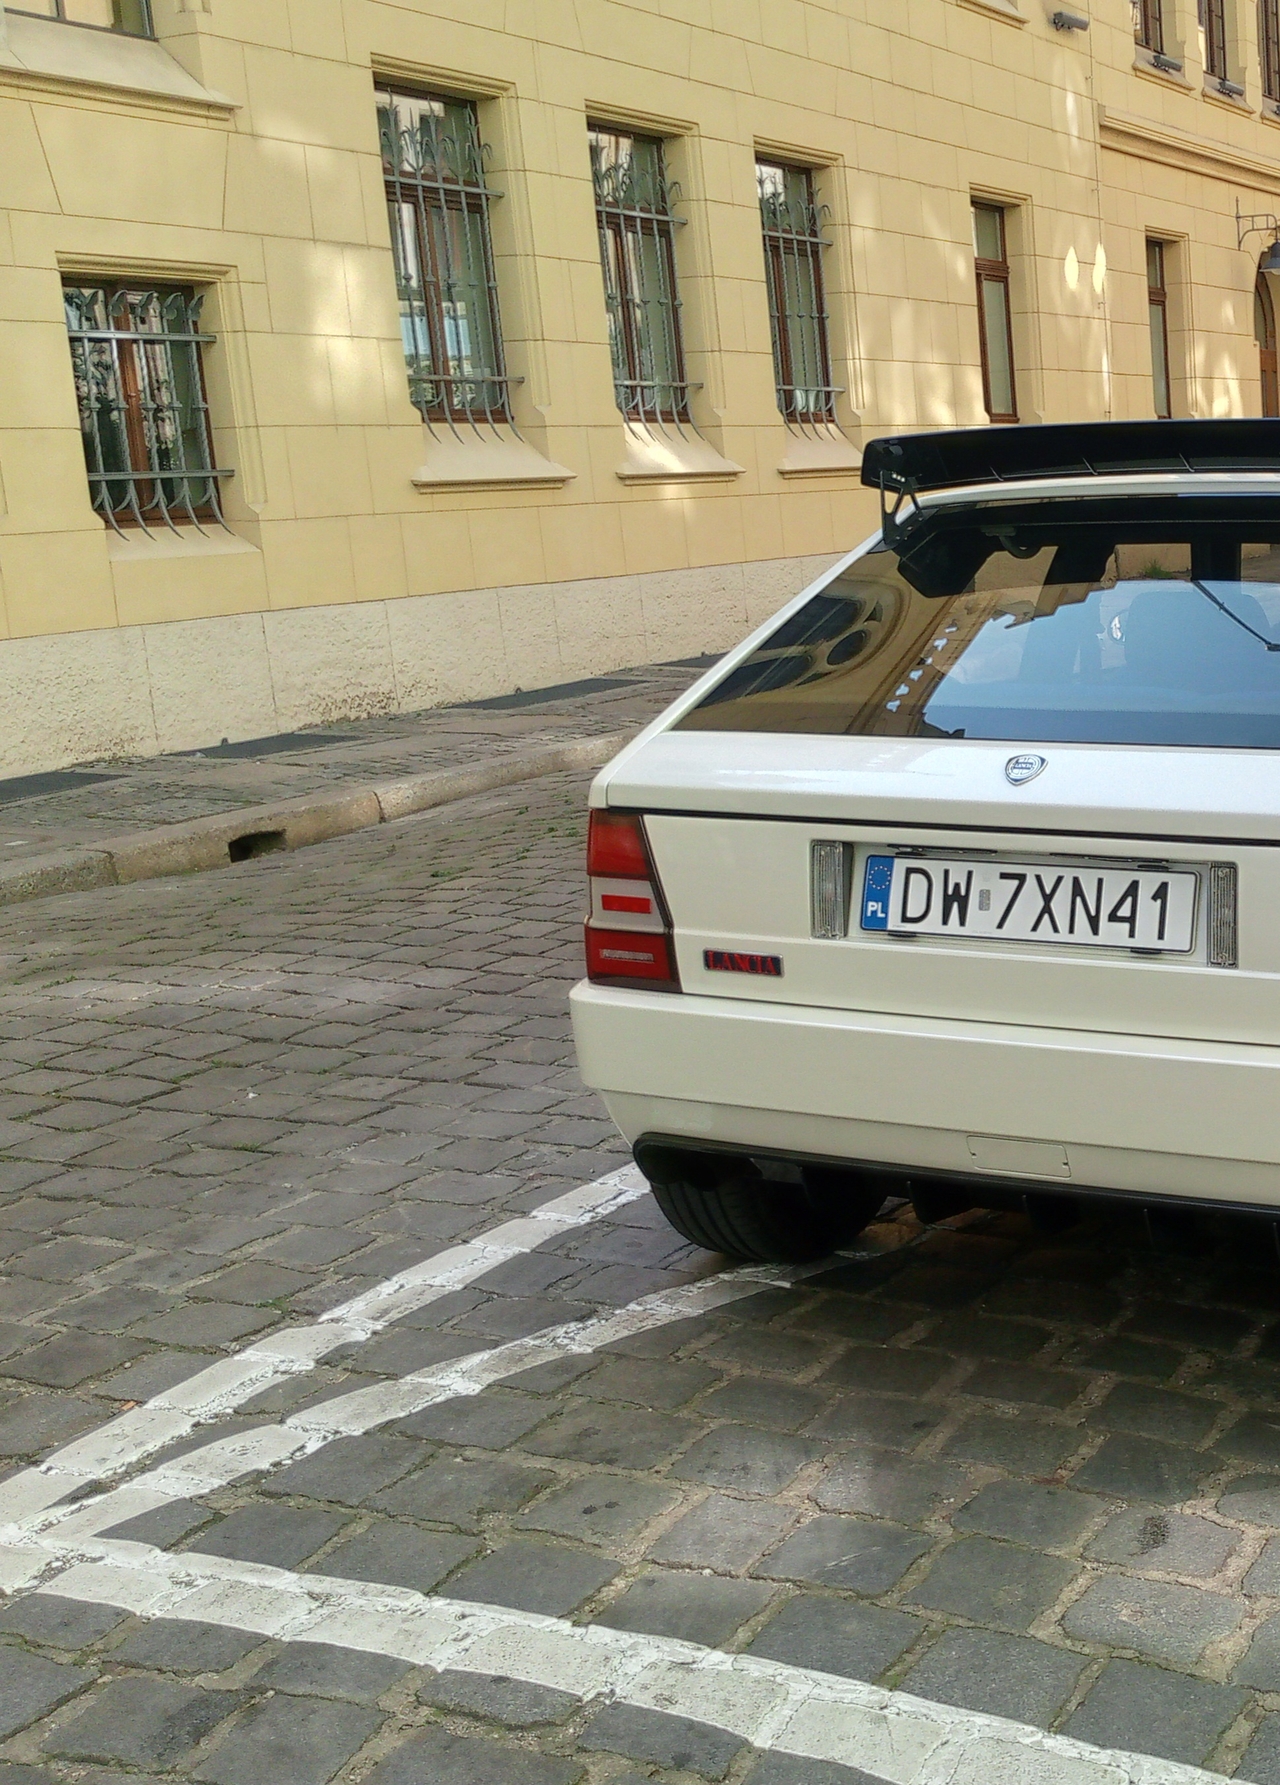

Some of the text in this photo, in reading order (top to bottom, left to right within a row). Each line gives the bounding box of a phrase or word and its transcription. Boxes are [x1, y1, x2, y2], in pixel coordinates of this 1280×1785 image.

[866, 901, 886, 918] PL
[901, 866, 1170, 941] DW 7XN41
